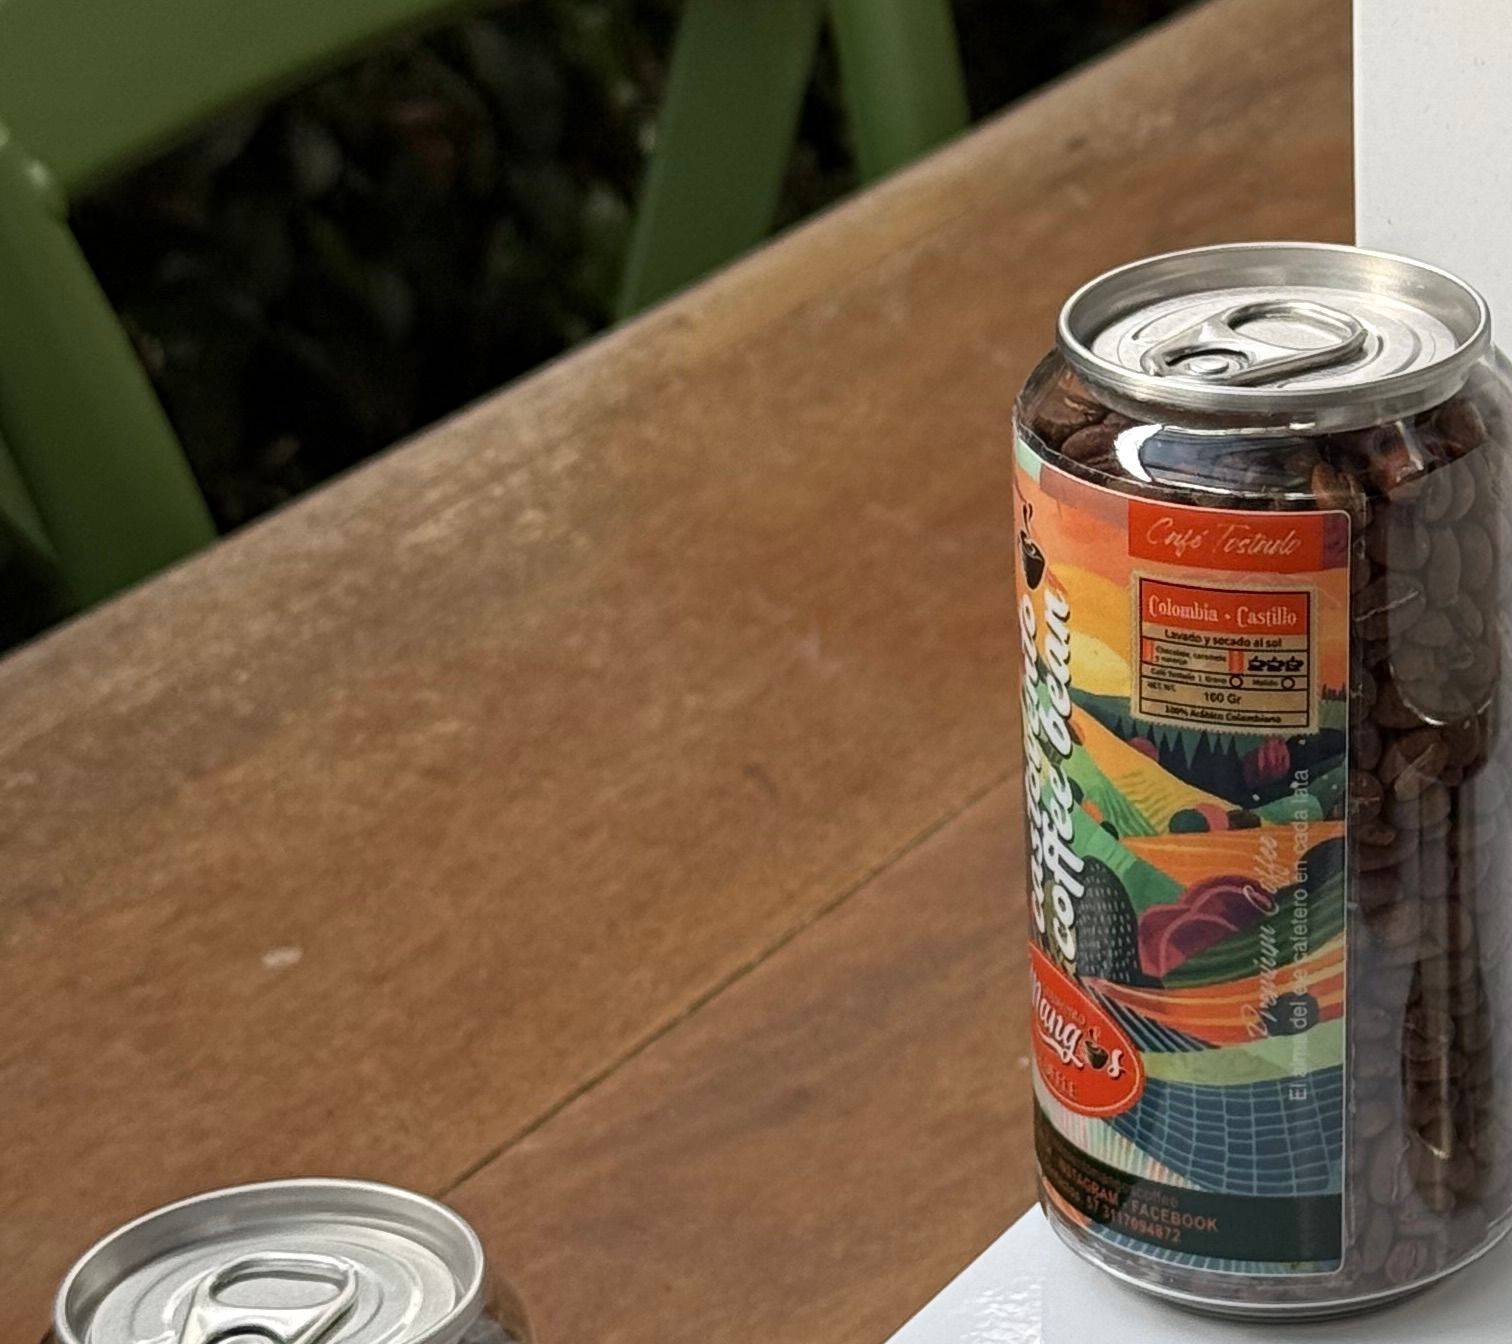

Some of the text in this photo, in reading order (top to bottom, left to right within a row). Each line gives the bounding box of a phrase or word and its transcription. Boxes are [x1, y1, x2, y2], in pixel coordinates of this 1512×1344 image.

[1149, 594, 1297, 628] Colombia Castillo
[1266, 637, 1282, 648] sol
[1038, 588, 1072, 756] bean
[1292, 807, 1309, 854] cada
[1042, 764, 1085, 961] coffee
[1290, 886, 1309, 963] cafetero
[1292, 997, 1308, 1029] del
[1131, 1199, 1219, 1232] FACEBOOK
